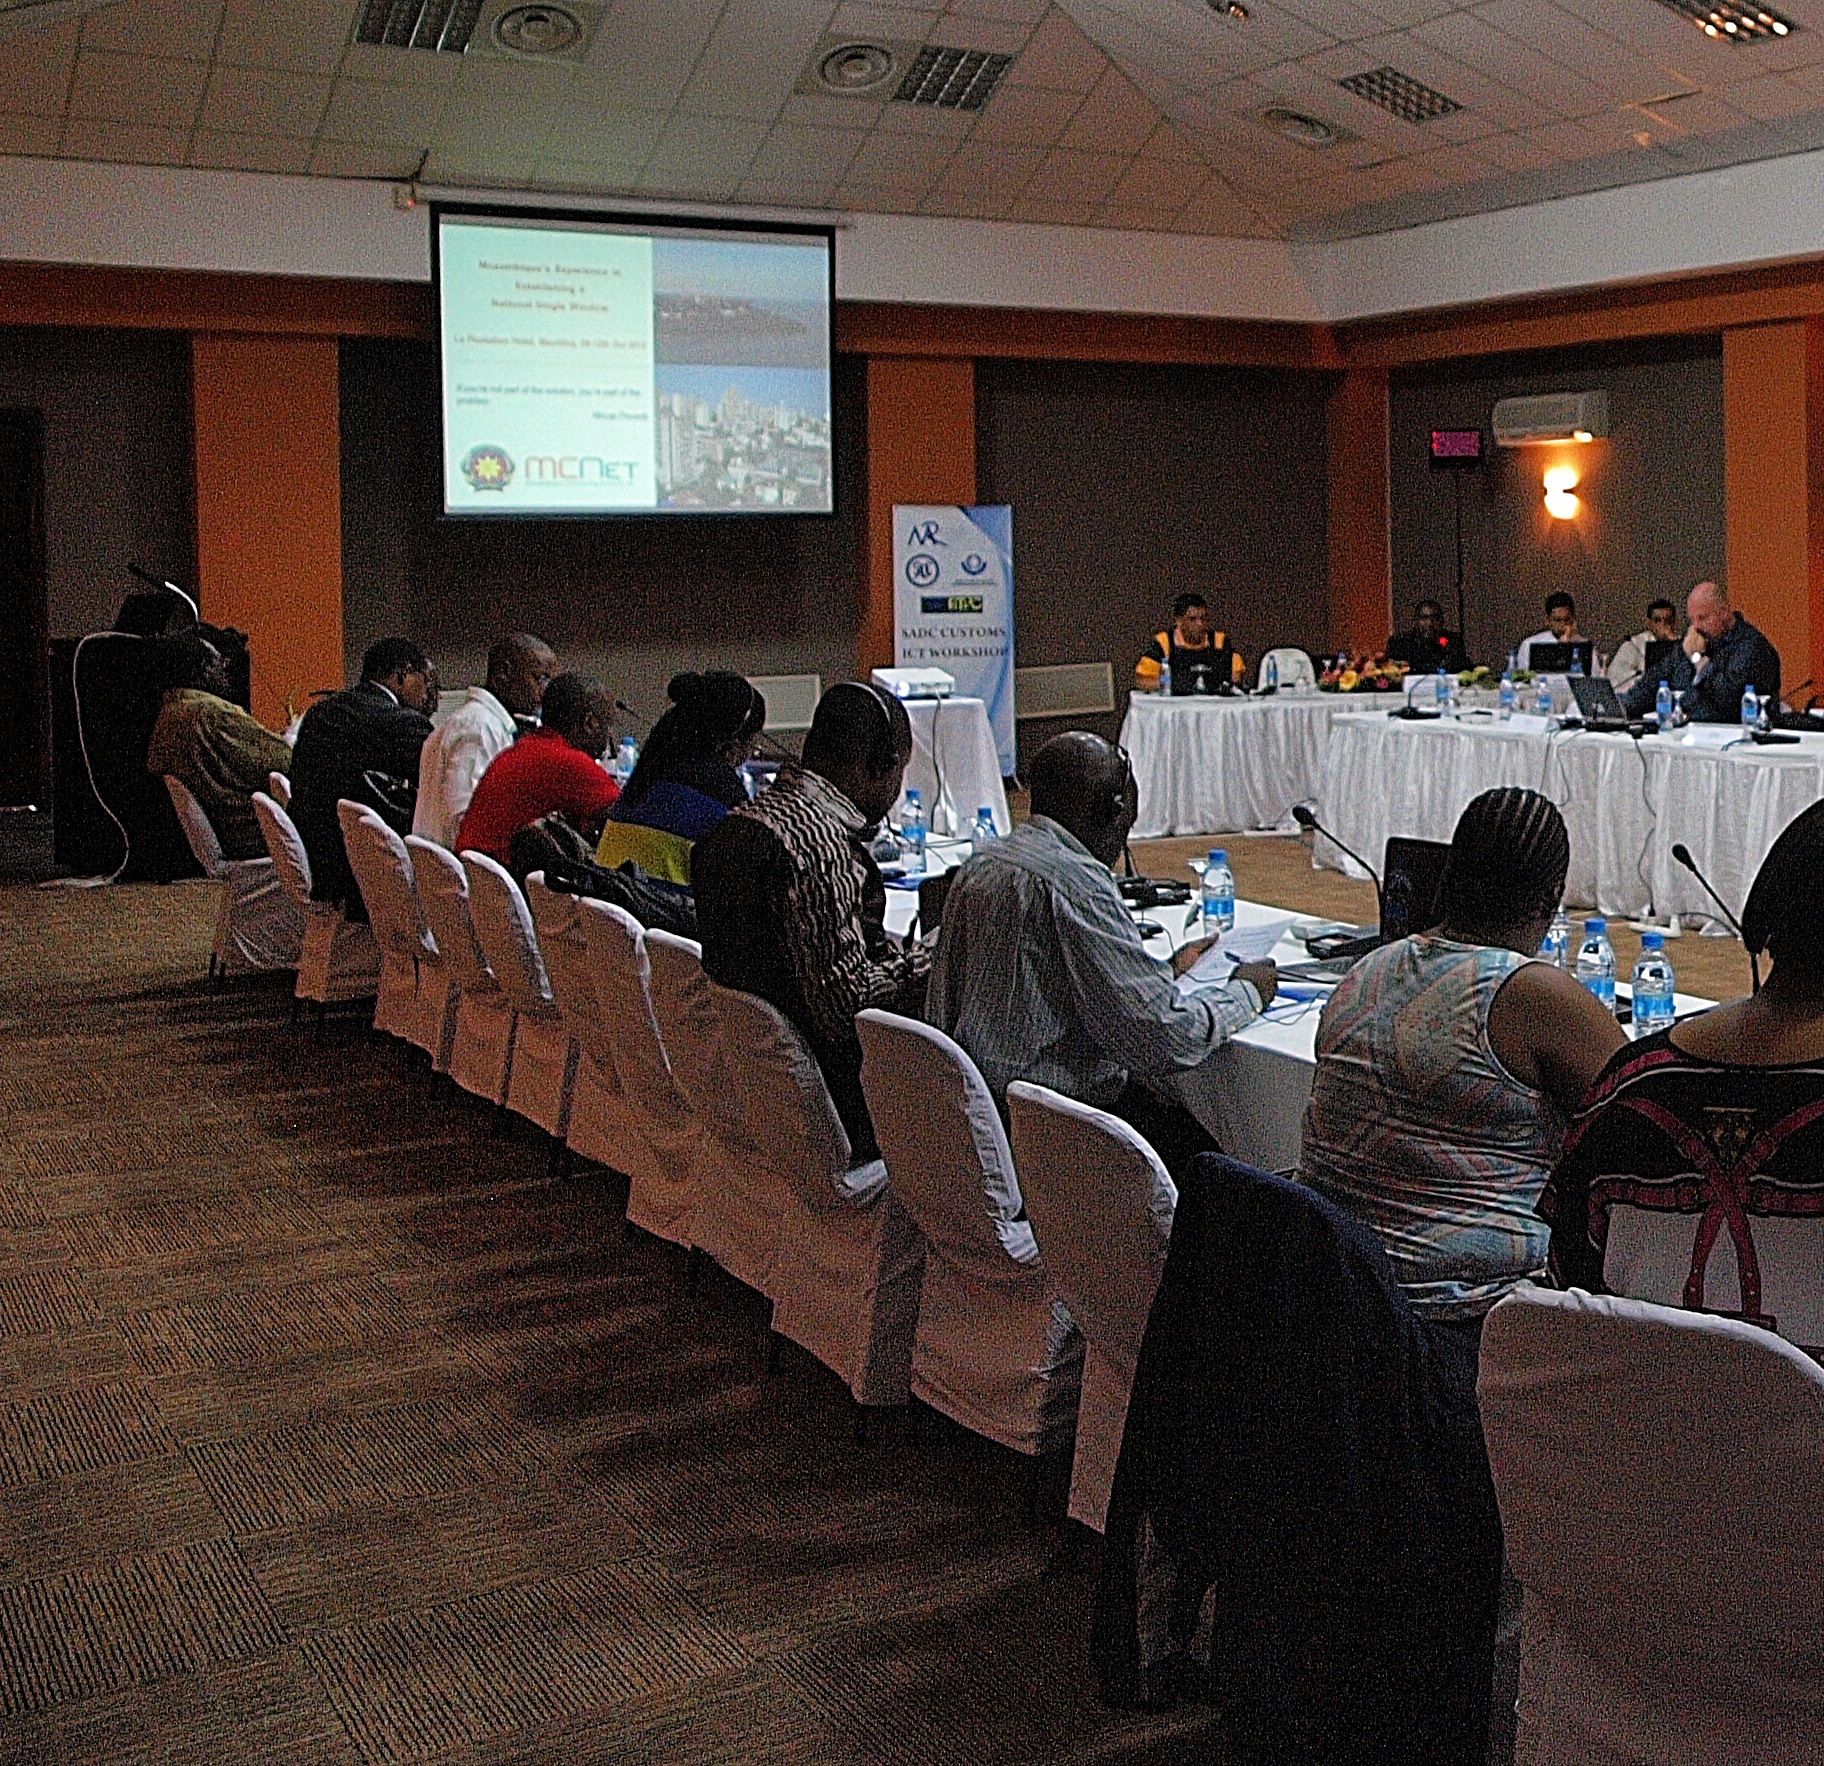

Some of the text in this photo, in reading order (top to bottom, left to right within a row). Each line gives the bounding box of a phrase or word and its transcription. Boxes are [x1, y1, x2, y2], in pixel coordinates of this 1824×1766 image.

[901, 627, 1006, 639] SADC CUSTOMS
[902, 647, 1009, 659] ICT WORKSHOP
